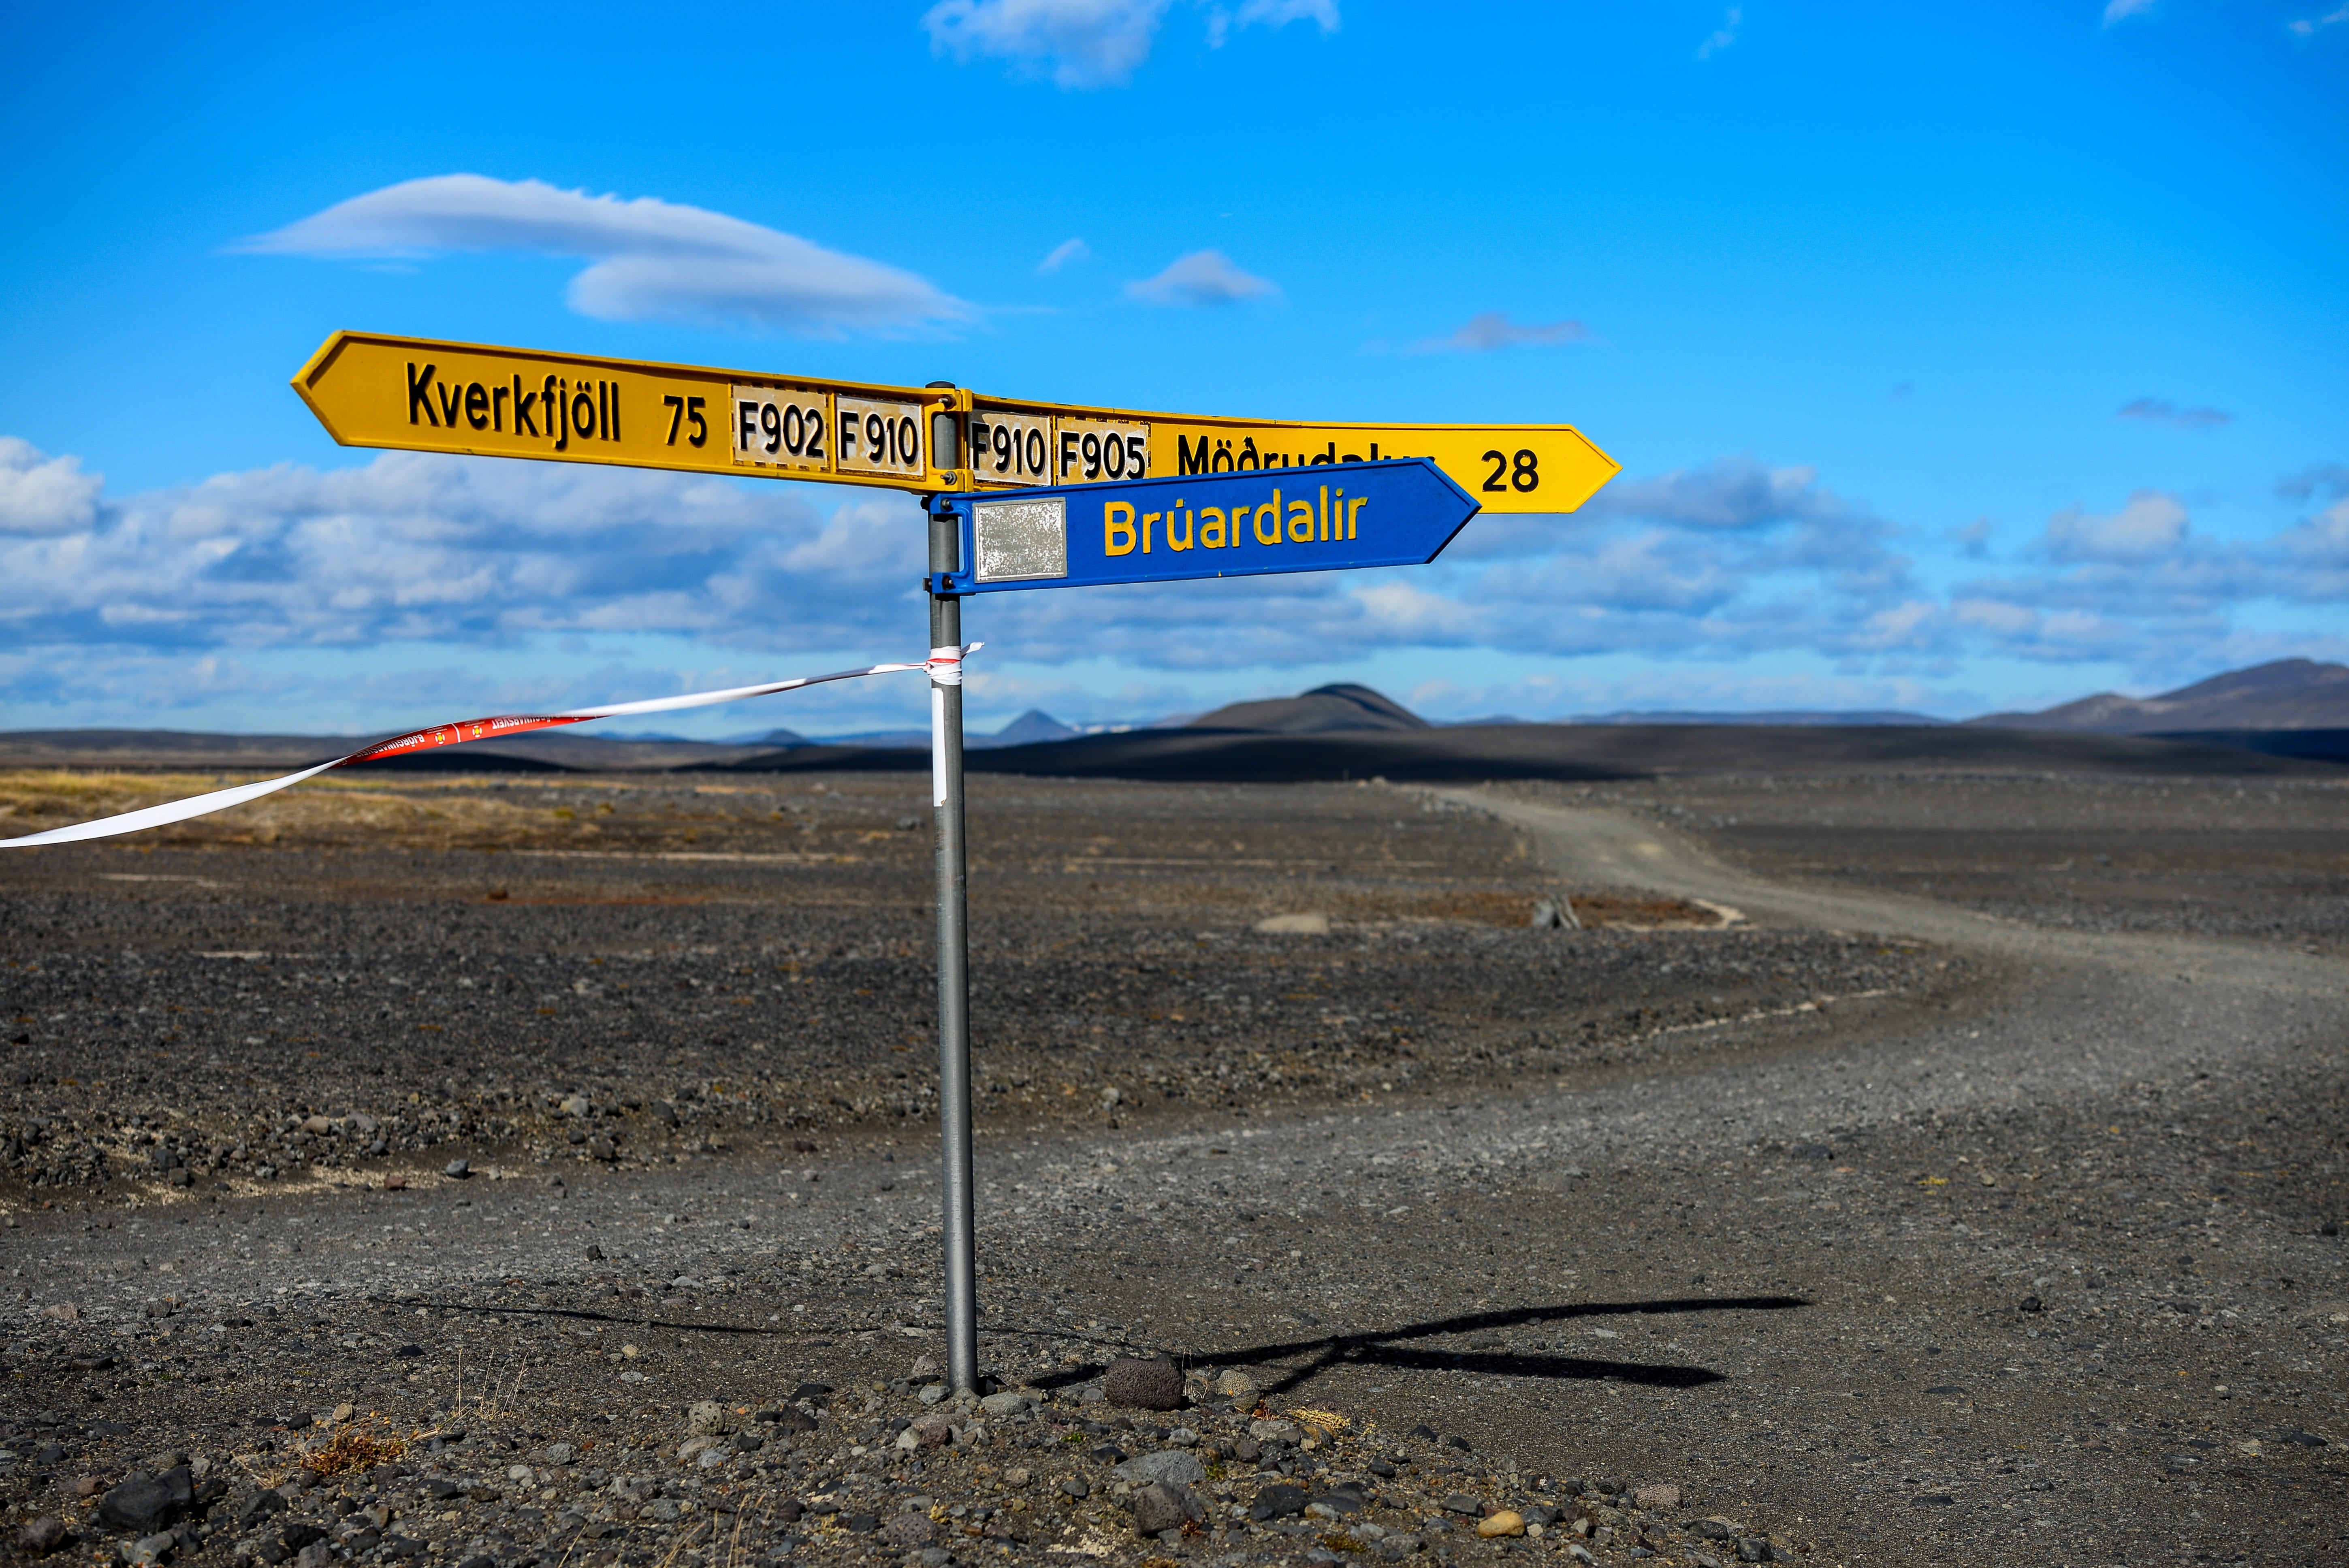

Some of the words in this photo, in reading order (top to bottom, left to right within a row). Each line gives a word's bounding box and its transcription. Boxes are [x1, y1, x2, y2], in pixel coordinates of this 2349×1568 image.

[406, 361, 621, 450] Kverkfjöll
[662, 394, 707, 447] 75
[737, 400, 824, 458] F902
[839, 411, 919, 465] F910
[970, 422, 1046, 476] F910
[1060, 431, 1146, 480] F905
[1481, 449, 1539, 493] 28
[1104, 485, 1368, 557] Brúardalir
